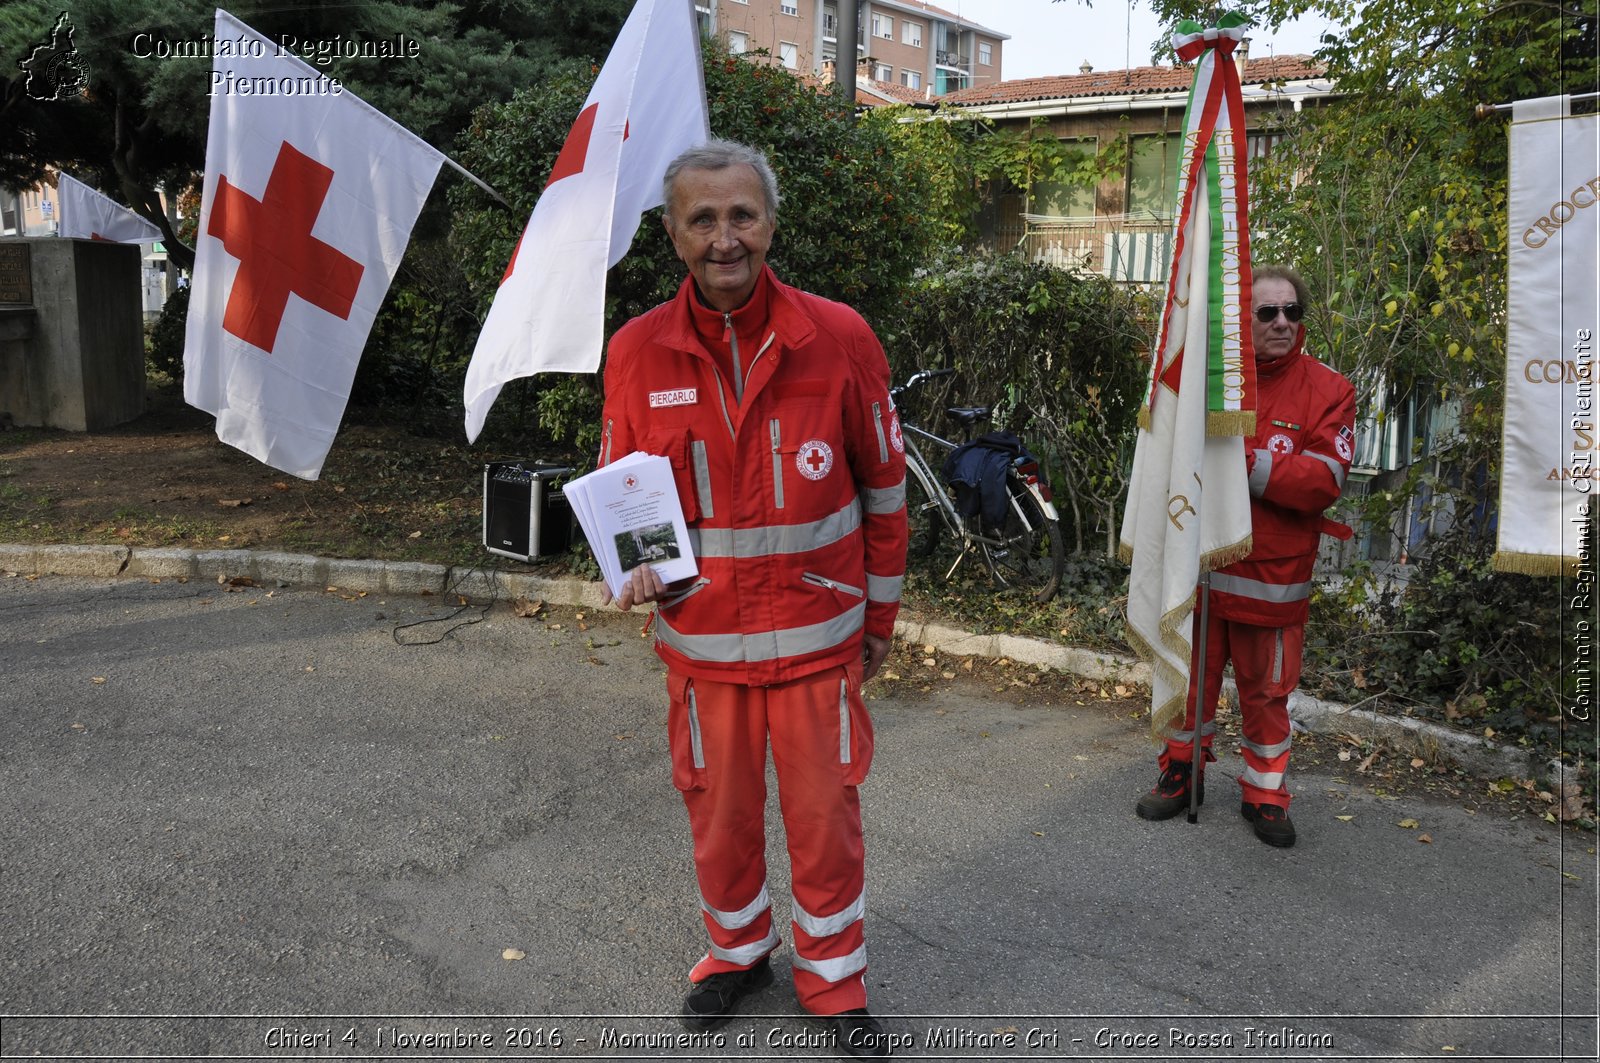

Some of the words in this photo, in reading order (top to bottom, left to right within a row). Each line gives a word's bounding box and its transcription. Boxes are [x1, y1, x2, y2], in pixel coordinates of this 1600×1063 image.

[1214, 128, 1238, 190] CHIERI
[1219, 196, 1239, 214] DI
[1221, 221, 1241, 298] LOCALE
[1222, 303, 1245, 401] COMITATO
[1524, 359, 1600, 384] COM
[650, 390, 696, 406] PIERCARLO
